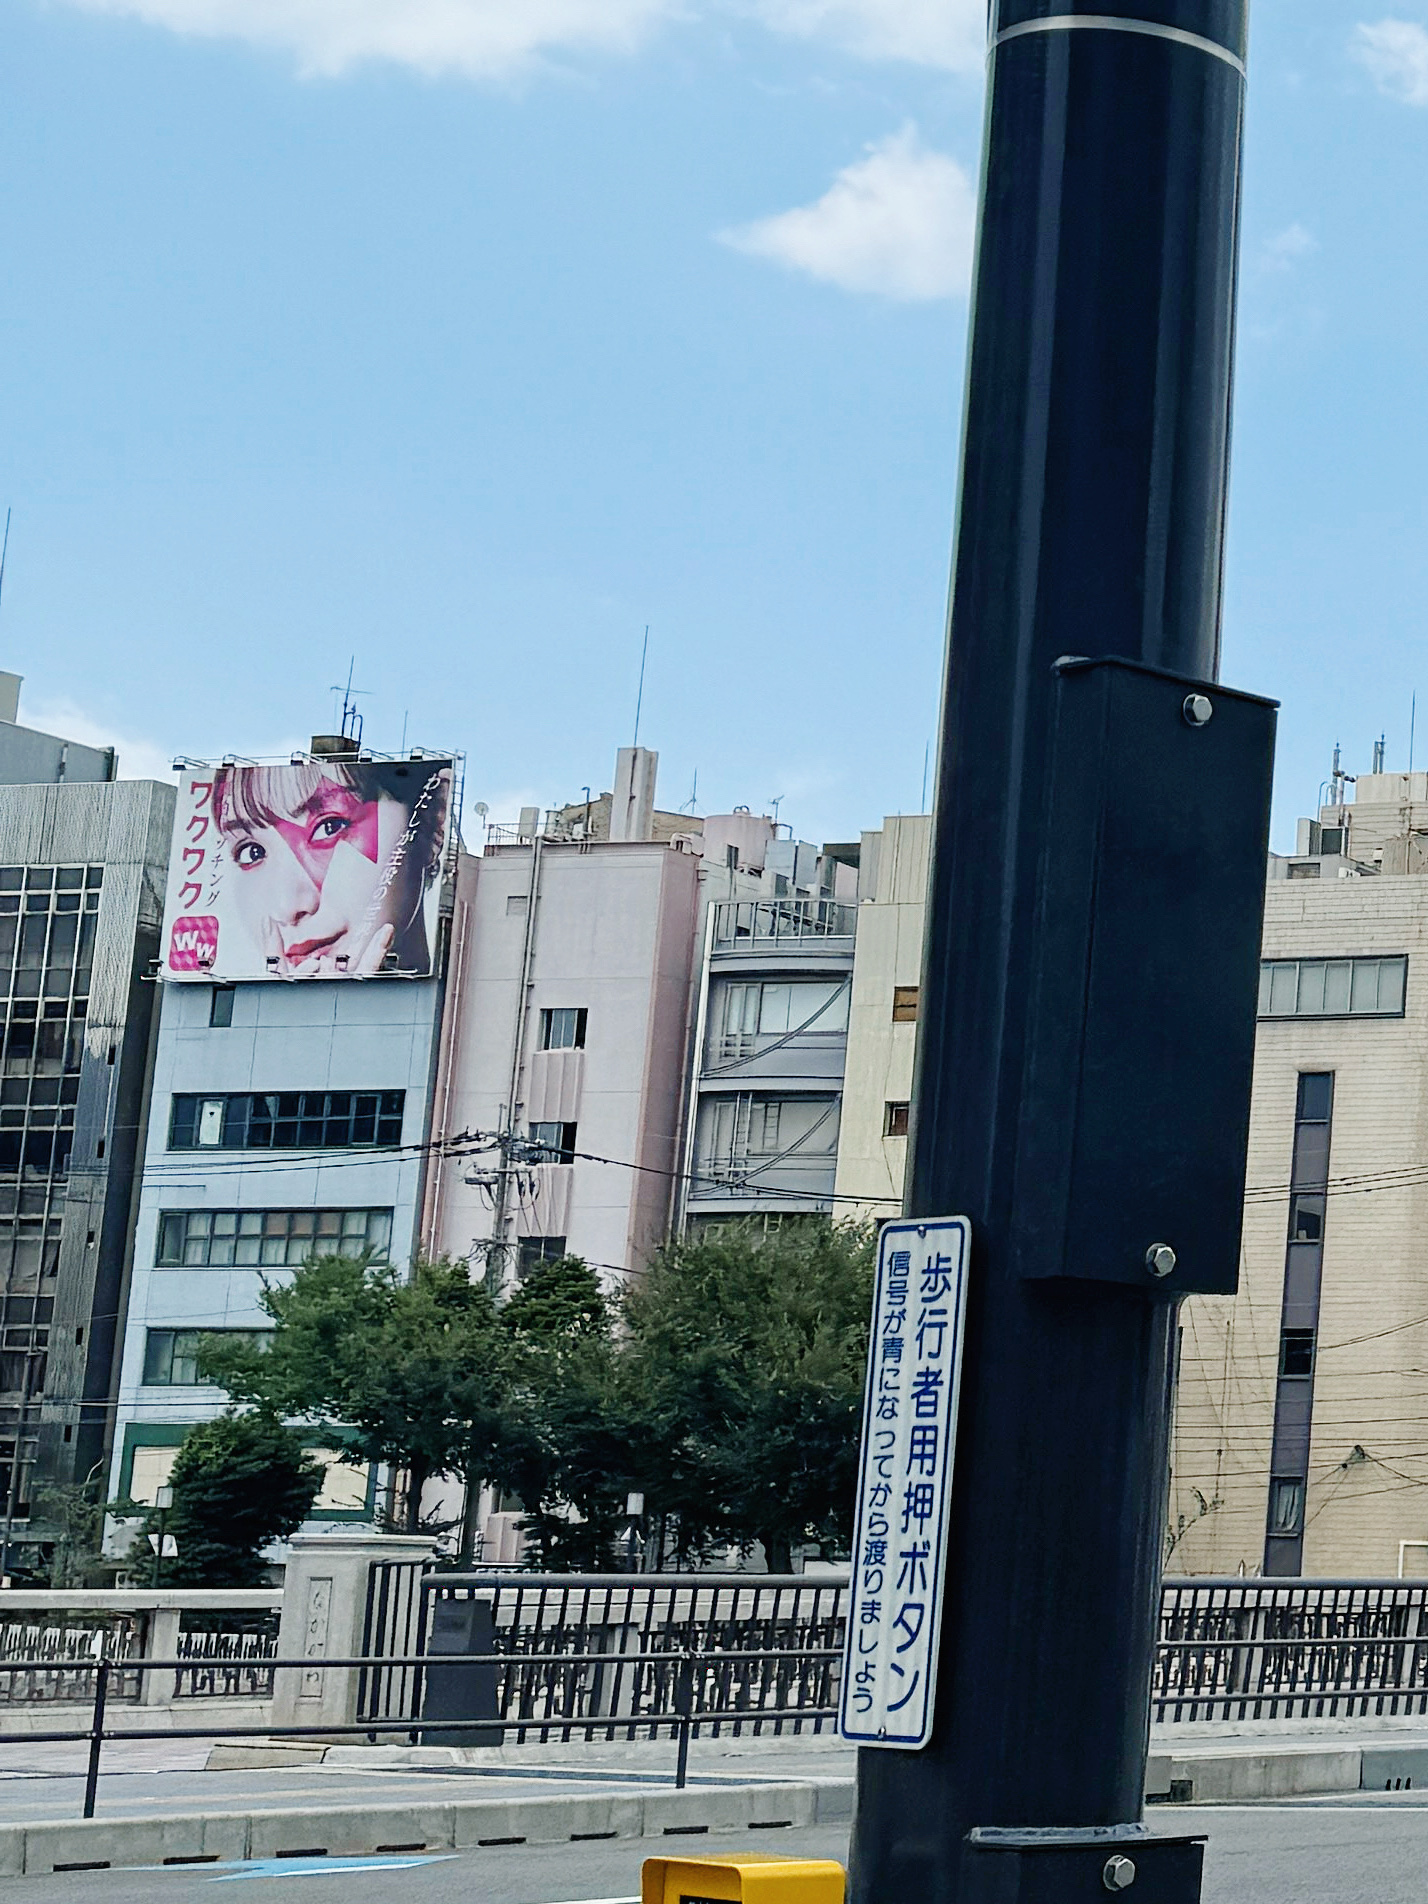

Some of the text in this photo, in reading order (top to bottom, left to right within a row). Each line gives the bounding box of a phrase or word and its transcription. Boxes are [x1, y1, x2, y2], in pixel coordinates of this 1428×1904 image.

[178, 781, 213, 910] ワクワク
[852, 1250, 911, 1714] 信号が青になってから渡りましょう
[886, 1251, 952, 1713] 歩行者用押ボタン
